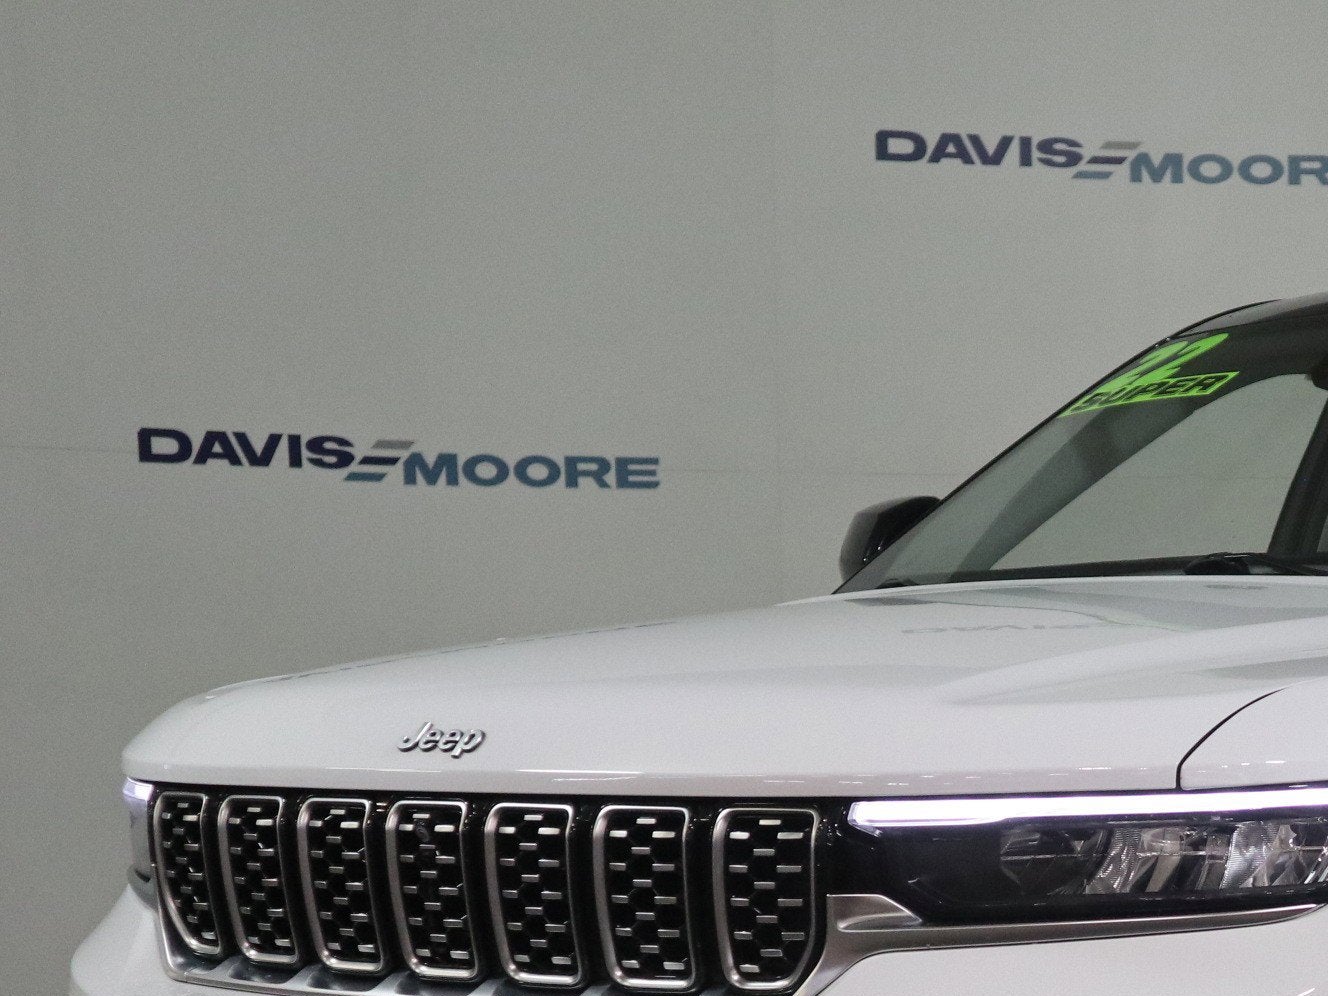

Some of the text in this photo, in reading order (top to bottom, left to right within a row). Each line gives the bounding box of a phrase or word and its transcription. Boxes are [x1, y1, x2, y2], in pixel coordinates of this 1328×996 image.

[875, 128, 1085, 168] DAVIS
[137, 427, 661, 489] DAVIS MOORE
[397, 721, 486, 759] Jeep
